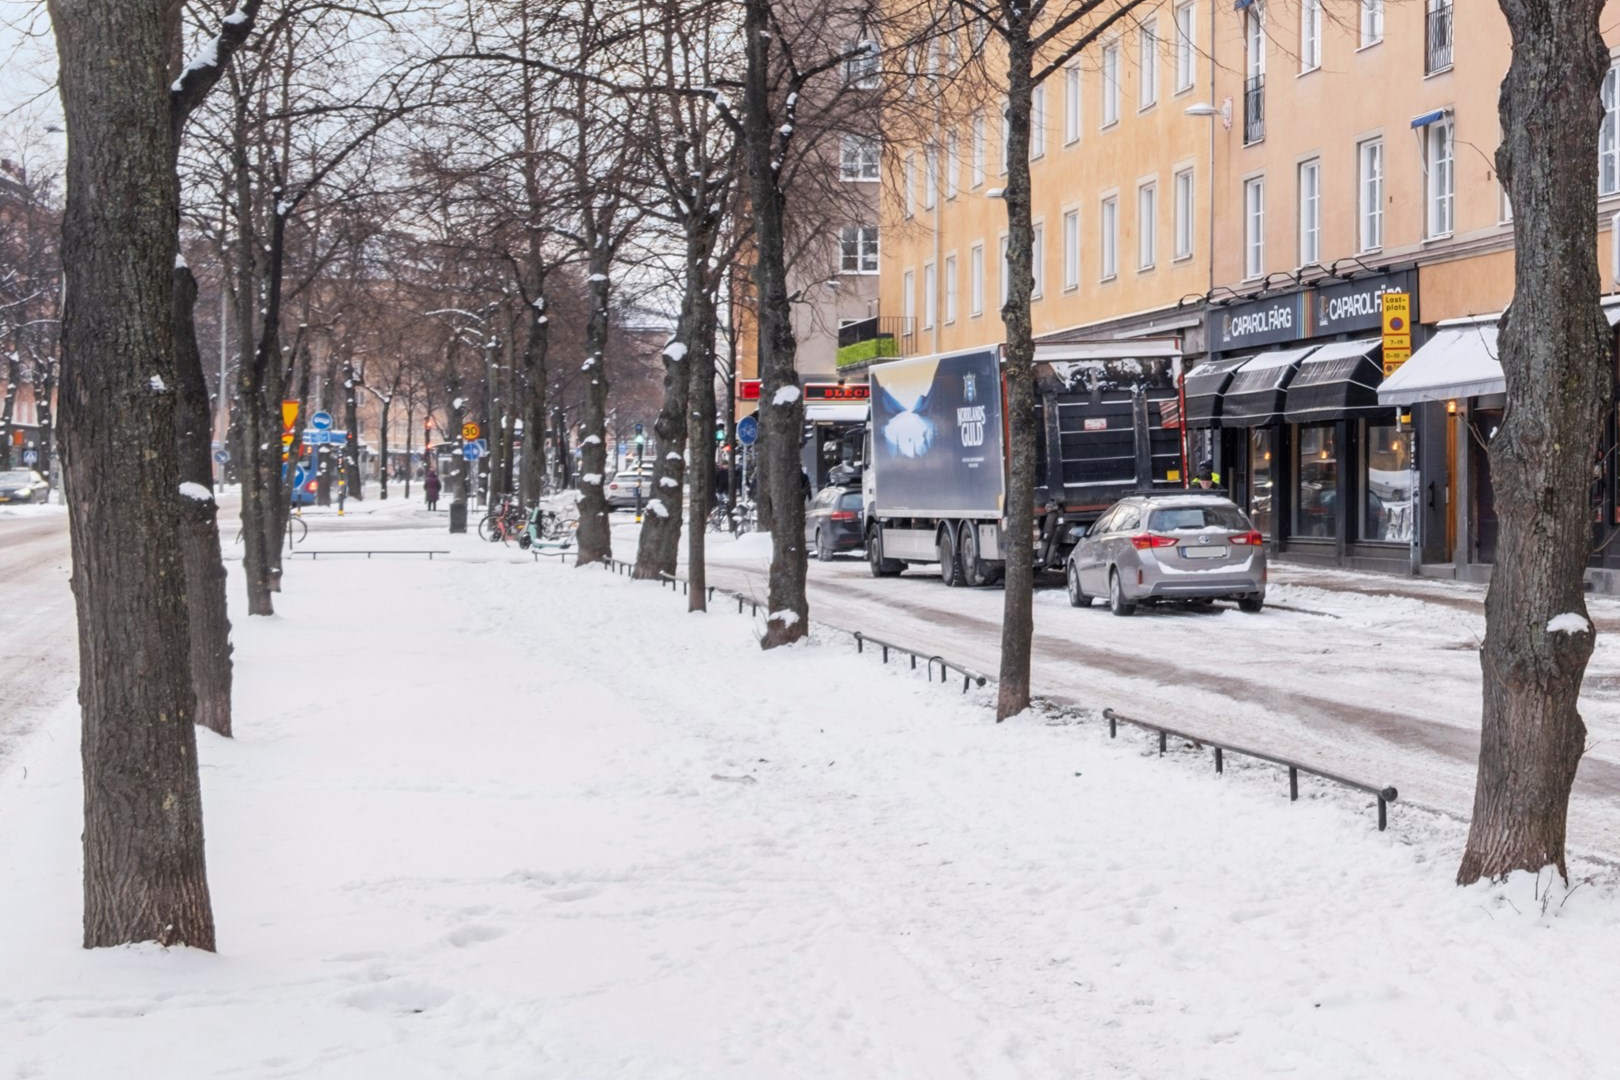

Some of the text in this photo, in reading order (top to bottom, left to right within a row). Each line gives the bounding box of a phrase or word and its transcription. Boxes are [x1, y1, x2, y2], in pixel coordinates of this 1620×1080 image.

[1329, 292, 1374, 320] CAPAROL
[1385, 296, 1406, 304] Last-
[1386, 304, 1406, 313] plats
[1231, 305, 1292, 337] CAPAROL FÄRG
[463, 426, 478, 436] 30
[961, 421, 984, 447] GULD
